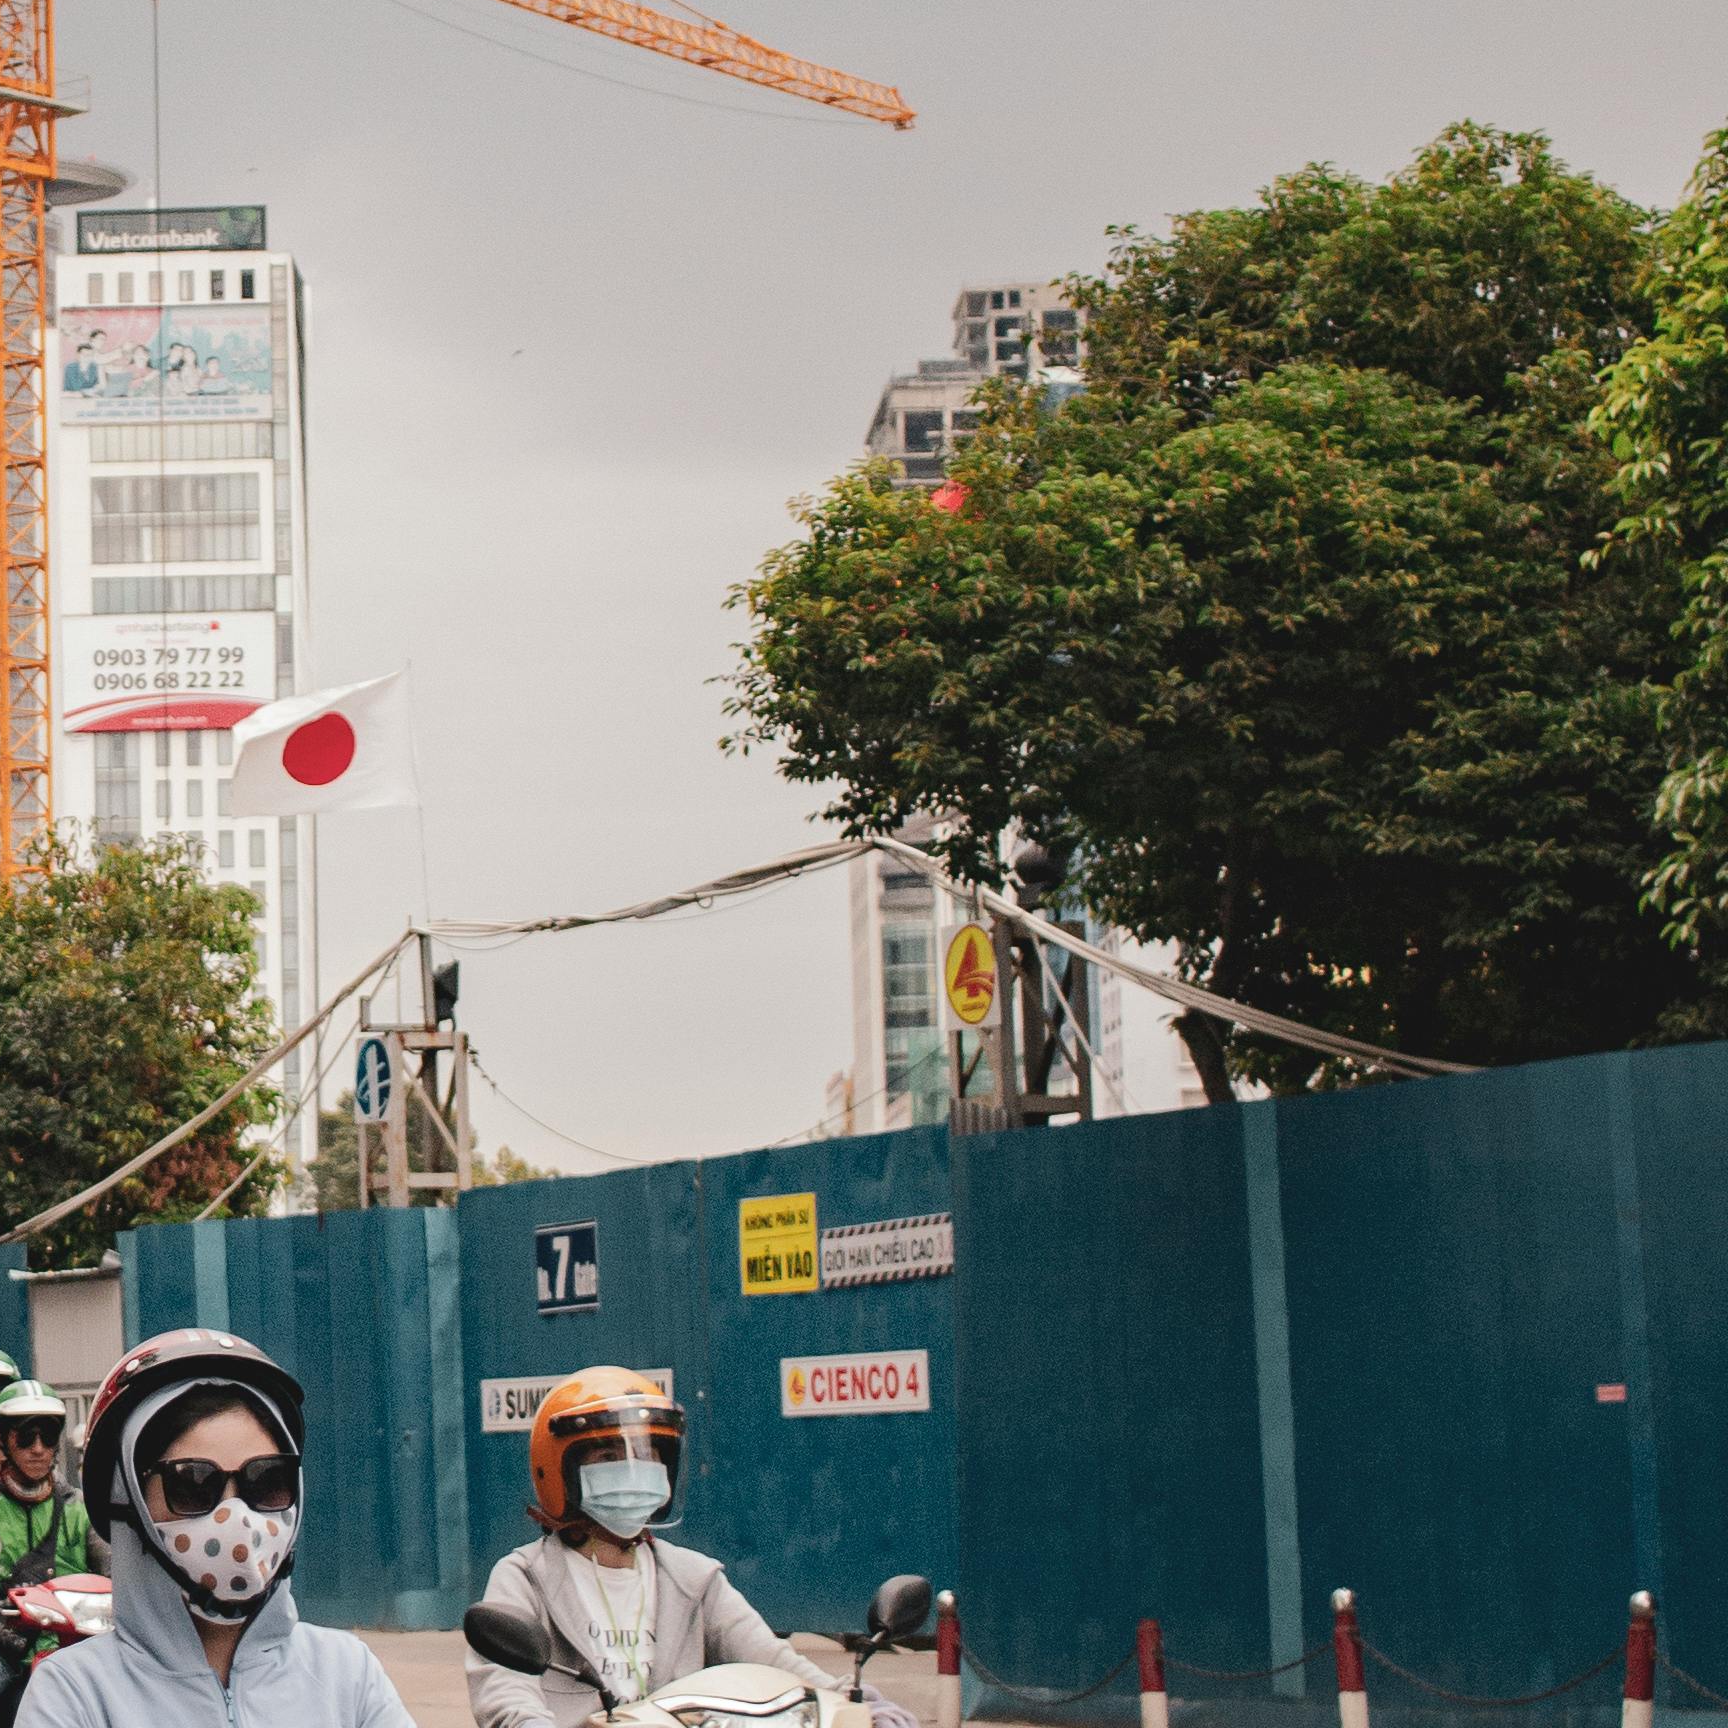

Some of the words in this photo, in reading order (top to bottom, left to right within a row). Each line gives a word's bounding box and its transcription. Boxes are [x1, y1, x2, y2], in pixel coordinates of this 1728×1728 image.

[87, 227, 219, 250] Vietcombank
[93, 648, 146, 666] 0903
[153, 647, 179, 665] 79
[186, 647, 211, 664] 77
[218, 646, 244, 663] 99
[93, 673, 147, 690] 0906
[153, 671, 179, 689] 68
[186, 671, 211, 688] 22
[218, 670, 244, 687] 22
[911, 1238, 934, 1261] CAO
[552, 1235, 570, 1300] 7
[810, 1362, 900, 1403] CIENCO
[905, 1362, 919, 1397] 4
